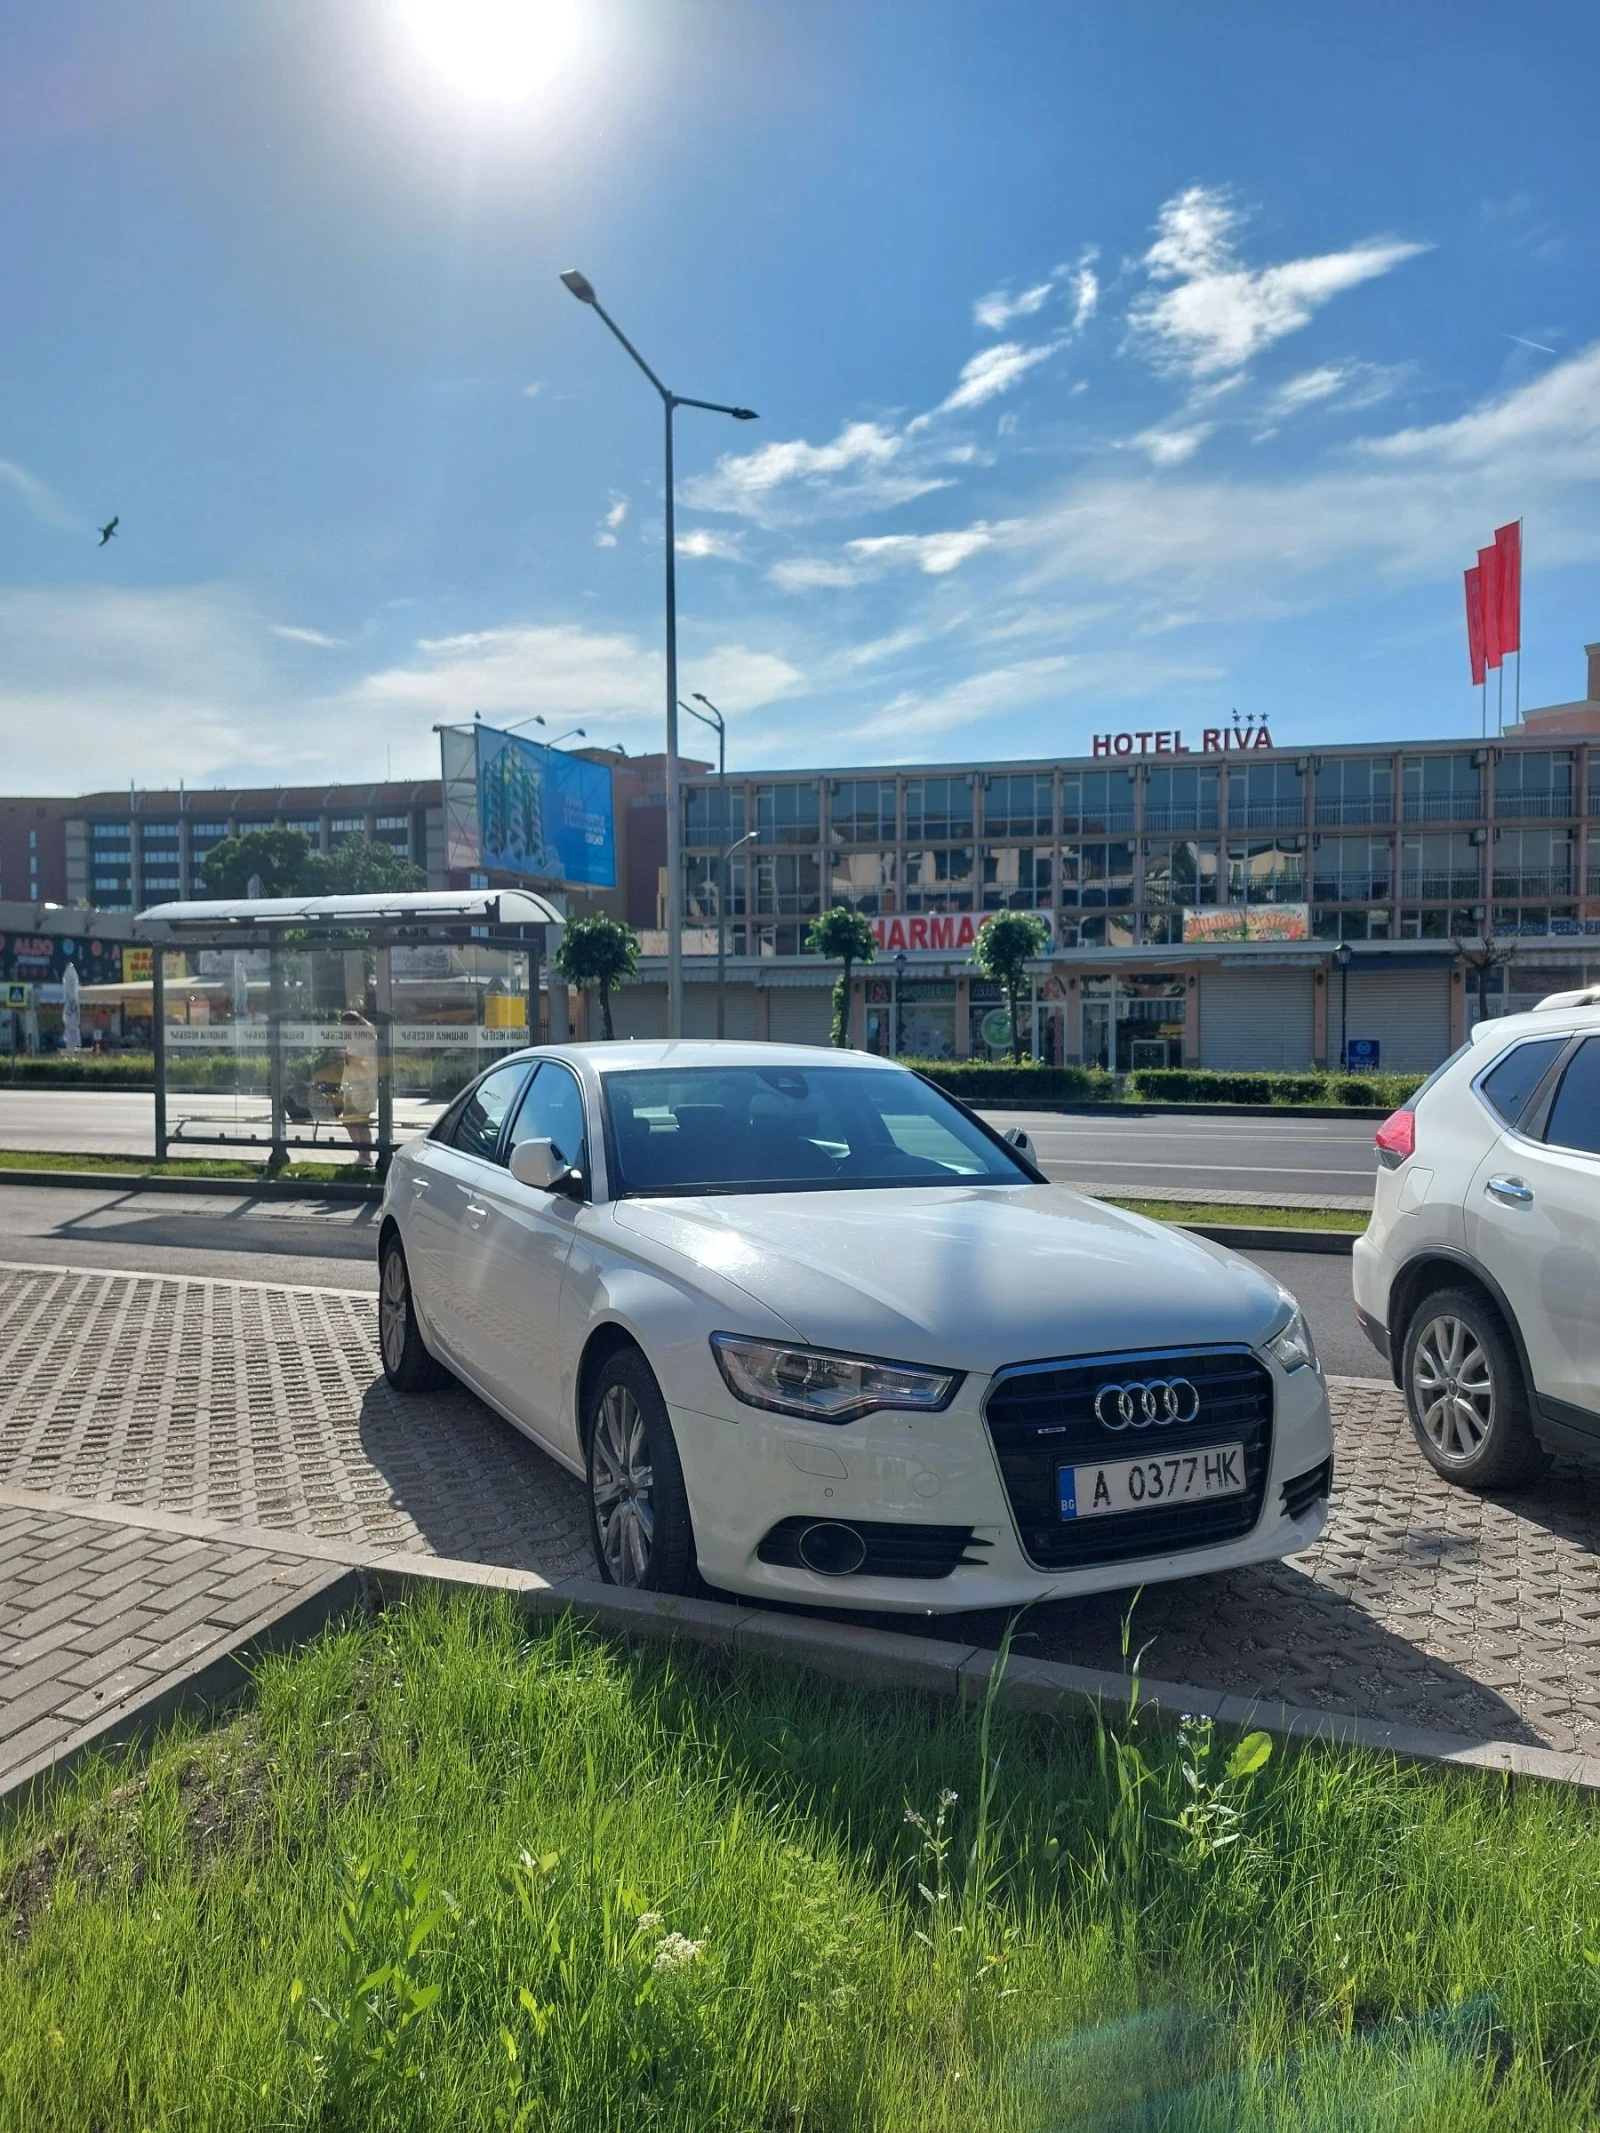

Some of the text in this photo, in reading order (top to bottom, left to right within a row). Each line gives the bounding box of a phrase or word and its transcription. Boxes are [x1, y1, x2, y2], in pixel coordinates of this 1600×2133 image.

[1093, 726, 1273, 758] HOTEL RIVA
[1061, 1499, 1075, 1511] BG
[1093, 1470, 1111, 1508] A
